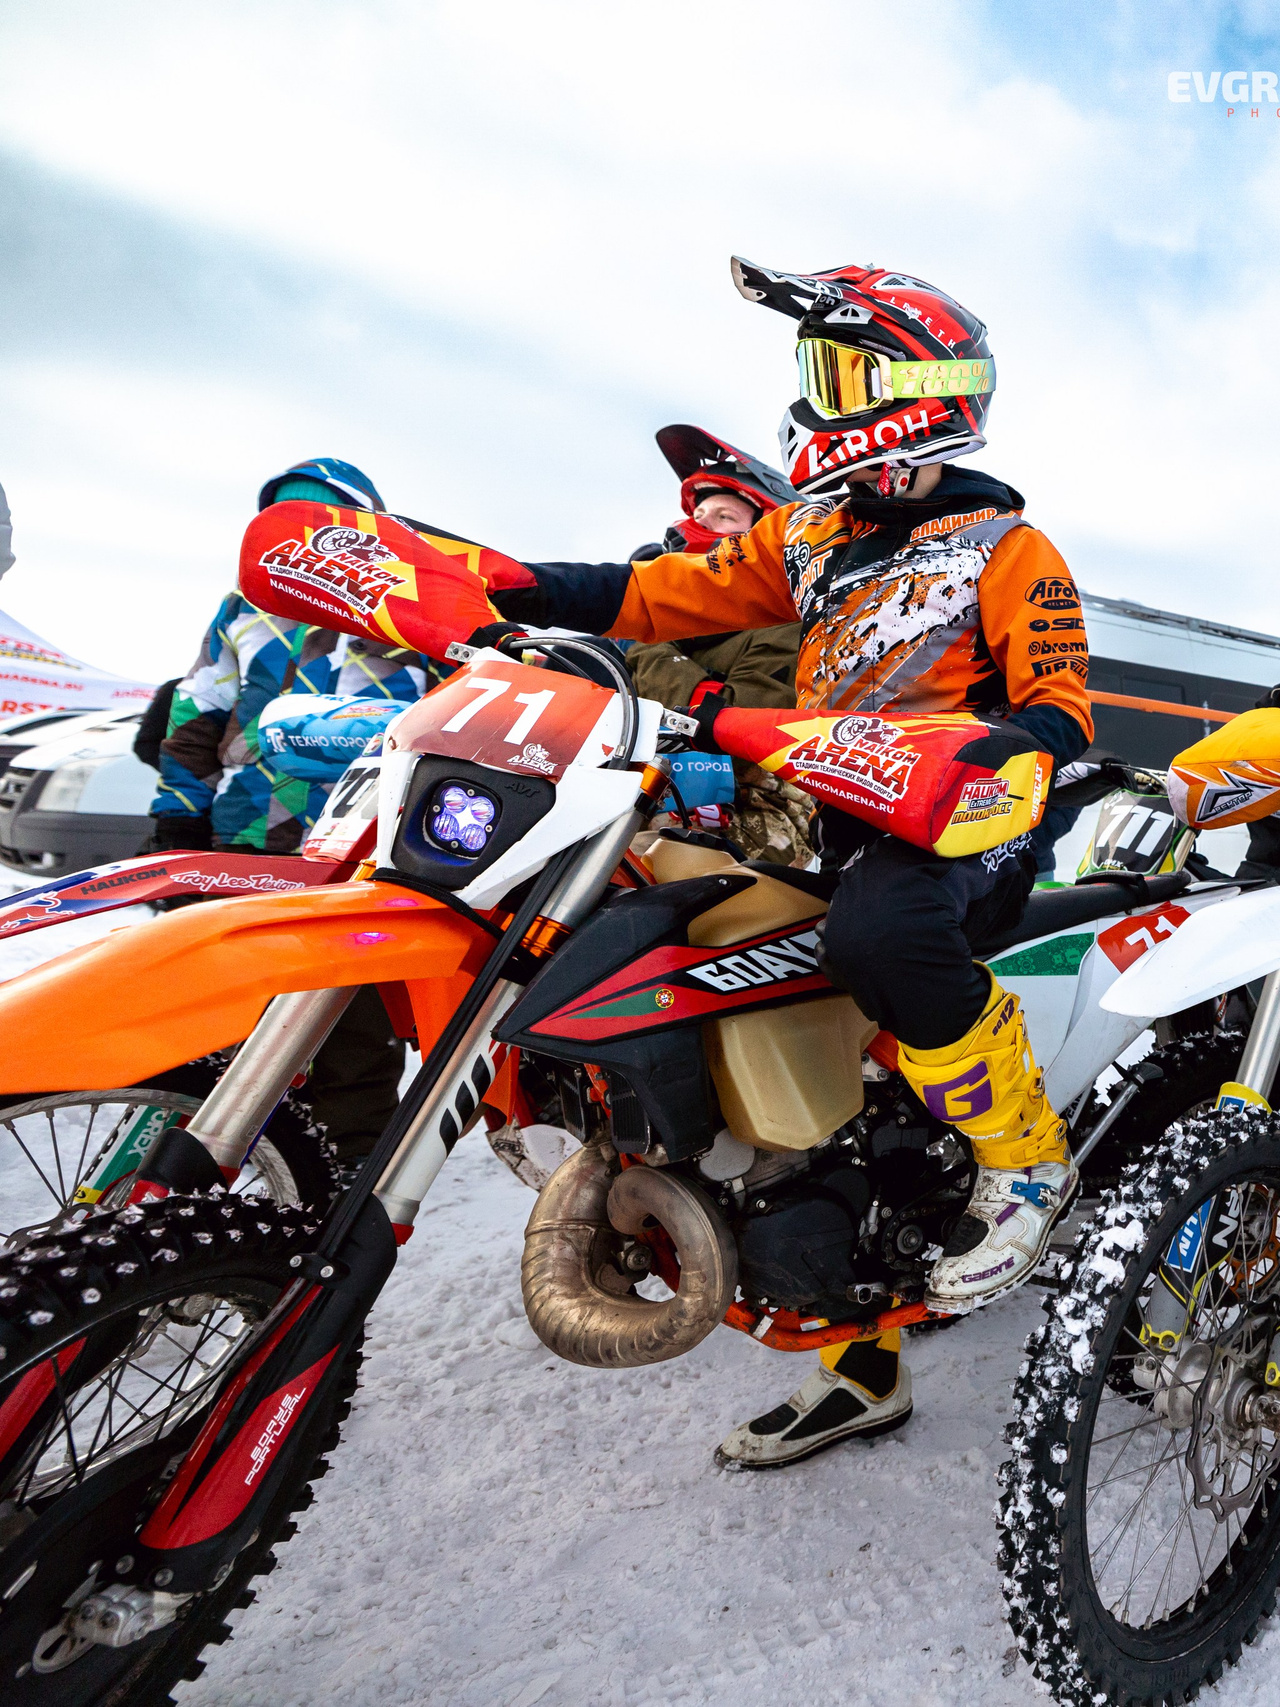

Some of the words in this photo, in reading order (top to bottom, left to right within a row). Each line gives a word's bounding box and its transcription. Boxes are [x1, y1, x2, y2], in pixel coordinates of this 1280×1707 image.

[900, 362, 989, 394] 100%
[807, 410, 929, 477] AIROH
[911, 508, 996, 541] ВЛАДИМИР
[263, 541, 392, 609] ARENA
[333, 553, 406, 585] NAIKOM
[269, 566, 293, 576] СТАДИОН
[294, 571, 329, 590] ТЕХНИЧЕСКИХ
[329, 586, 347, 600] ВИДОВ
[347, 596, 367, 613] СПОРТА
[270, 579, 369, 627] NAIKOMARENA.RU
[441, 677, 556, 745] 71
[288, 735, 329, 748] ТЕХНО
[332, 735, 371, 748] ГОРО
[855, 739, 920, 764] NAIKOM
[687, 761, 732, 772] ГОРОД
[789, 736, 910, 795] ARENA
[796, 761, 819, 770] СТАДИОН
[820, 764, 855, 780] ТЕХНИЧЕСКИХ
[856, 775, 873, 789] ВИДОВ
[873, 784, 893, 800] СПОРТА
[796, 774, 895, 814] NAIKOMARENA.RU
[1096, 805, 1174, 856] 711
[170, 871, 214, 891] Troy
[217, 873, 250, 888] Lee
[1125, 915, 1179, 950] 71
[962, 1256, 1015, 1283] GAERNE
[244, 1387, 307, 1486] PORTUGAL
[250, 1393, 293, 1461] 6DAYS
